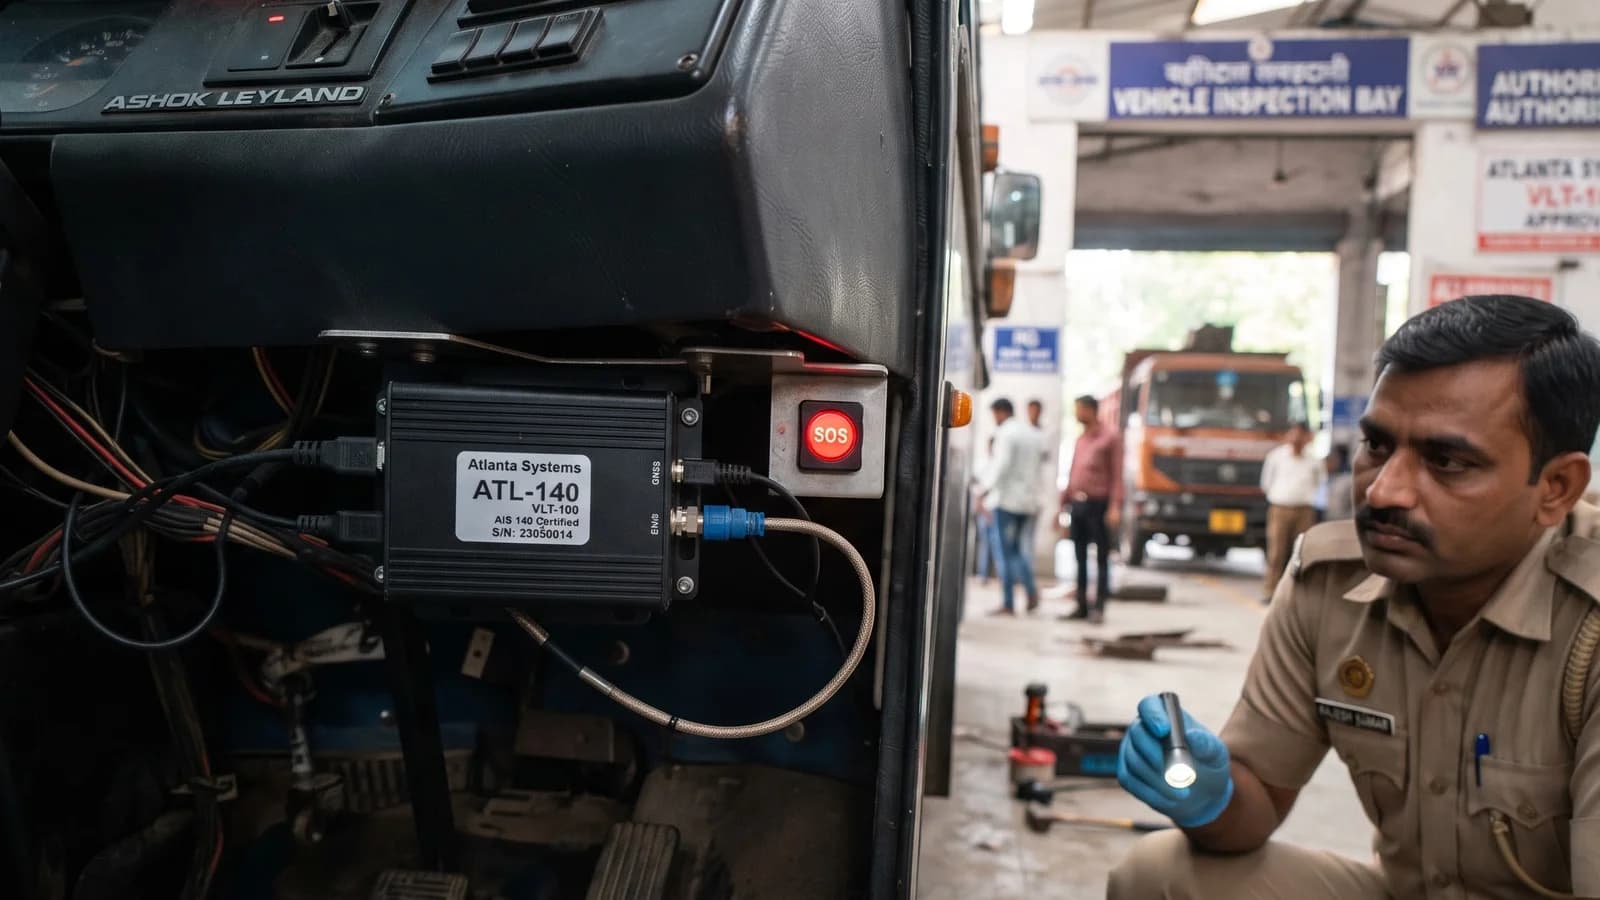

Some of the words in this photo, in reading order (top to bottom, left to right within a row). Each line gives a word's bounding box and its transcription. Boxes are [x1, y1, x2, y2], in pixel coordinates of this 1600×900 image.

[102, 91, 214, 110] ASHOK
[217, 86, 367, 106] LEYLAND
[1113, 87, 1209, 115] VEHICLE
[1213, 86, 1350, 114] INSPECTION
[1355, 86, 1403, 114] BAY
[1487, 160, 1573, 179] ATLANTA
[813, 426, 848, 444] SOS
[468, 459, 518, 472] Atlanta
[521, 460, 582, 475] Systems
[651, 460, 661, 486] GNSS
[473, 480, 580, 502] ATL-140
[532, 504, 579, 515] VLT-100
[494, 516, 513, 525] AIS
[516, 517, 533, 525] 140
[536, 517, 579, 527] Certified
[492, 528, 516, 538] S/N:
[520, 528, 573, 539] 23050014
